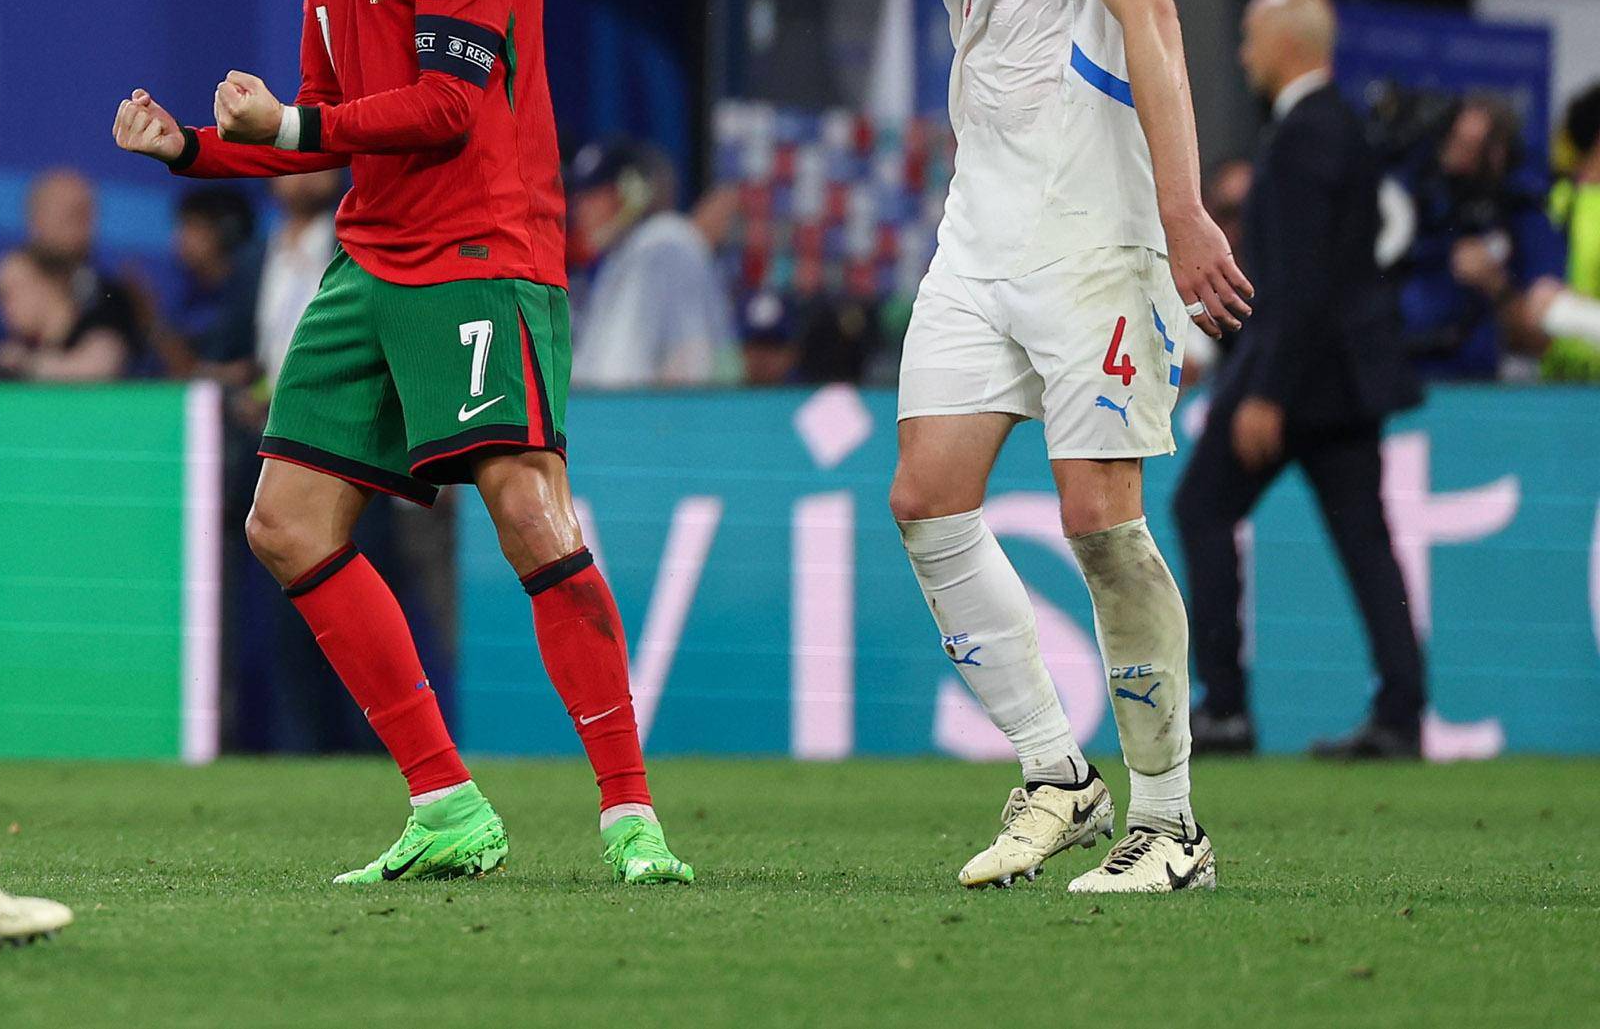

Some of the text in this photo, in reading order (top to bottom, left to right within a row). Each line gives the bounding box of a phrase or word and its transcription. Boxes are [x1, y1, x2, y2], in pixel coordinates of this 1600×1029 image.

[459, 319, 493, 397] 7
[1103, 315, 1137, 387] 4
[570, 382, 1521, 764] vist
[1110, 663, 1153, 679] CZE
